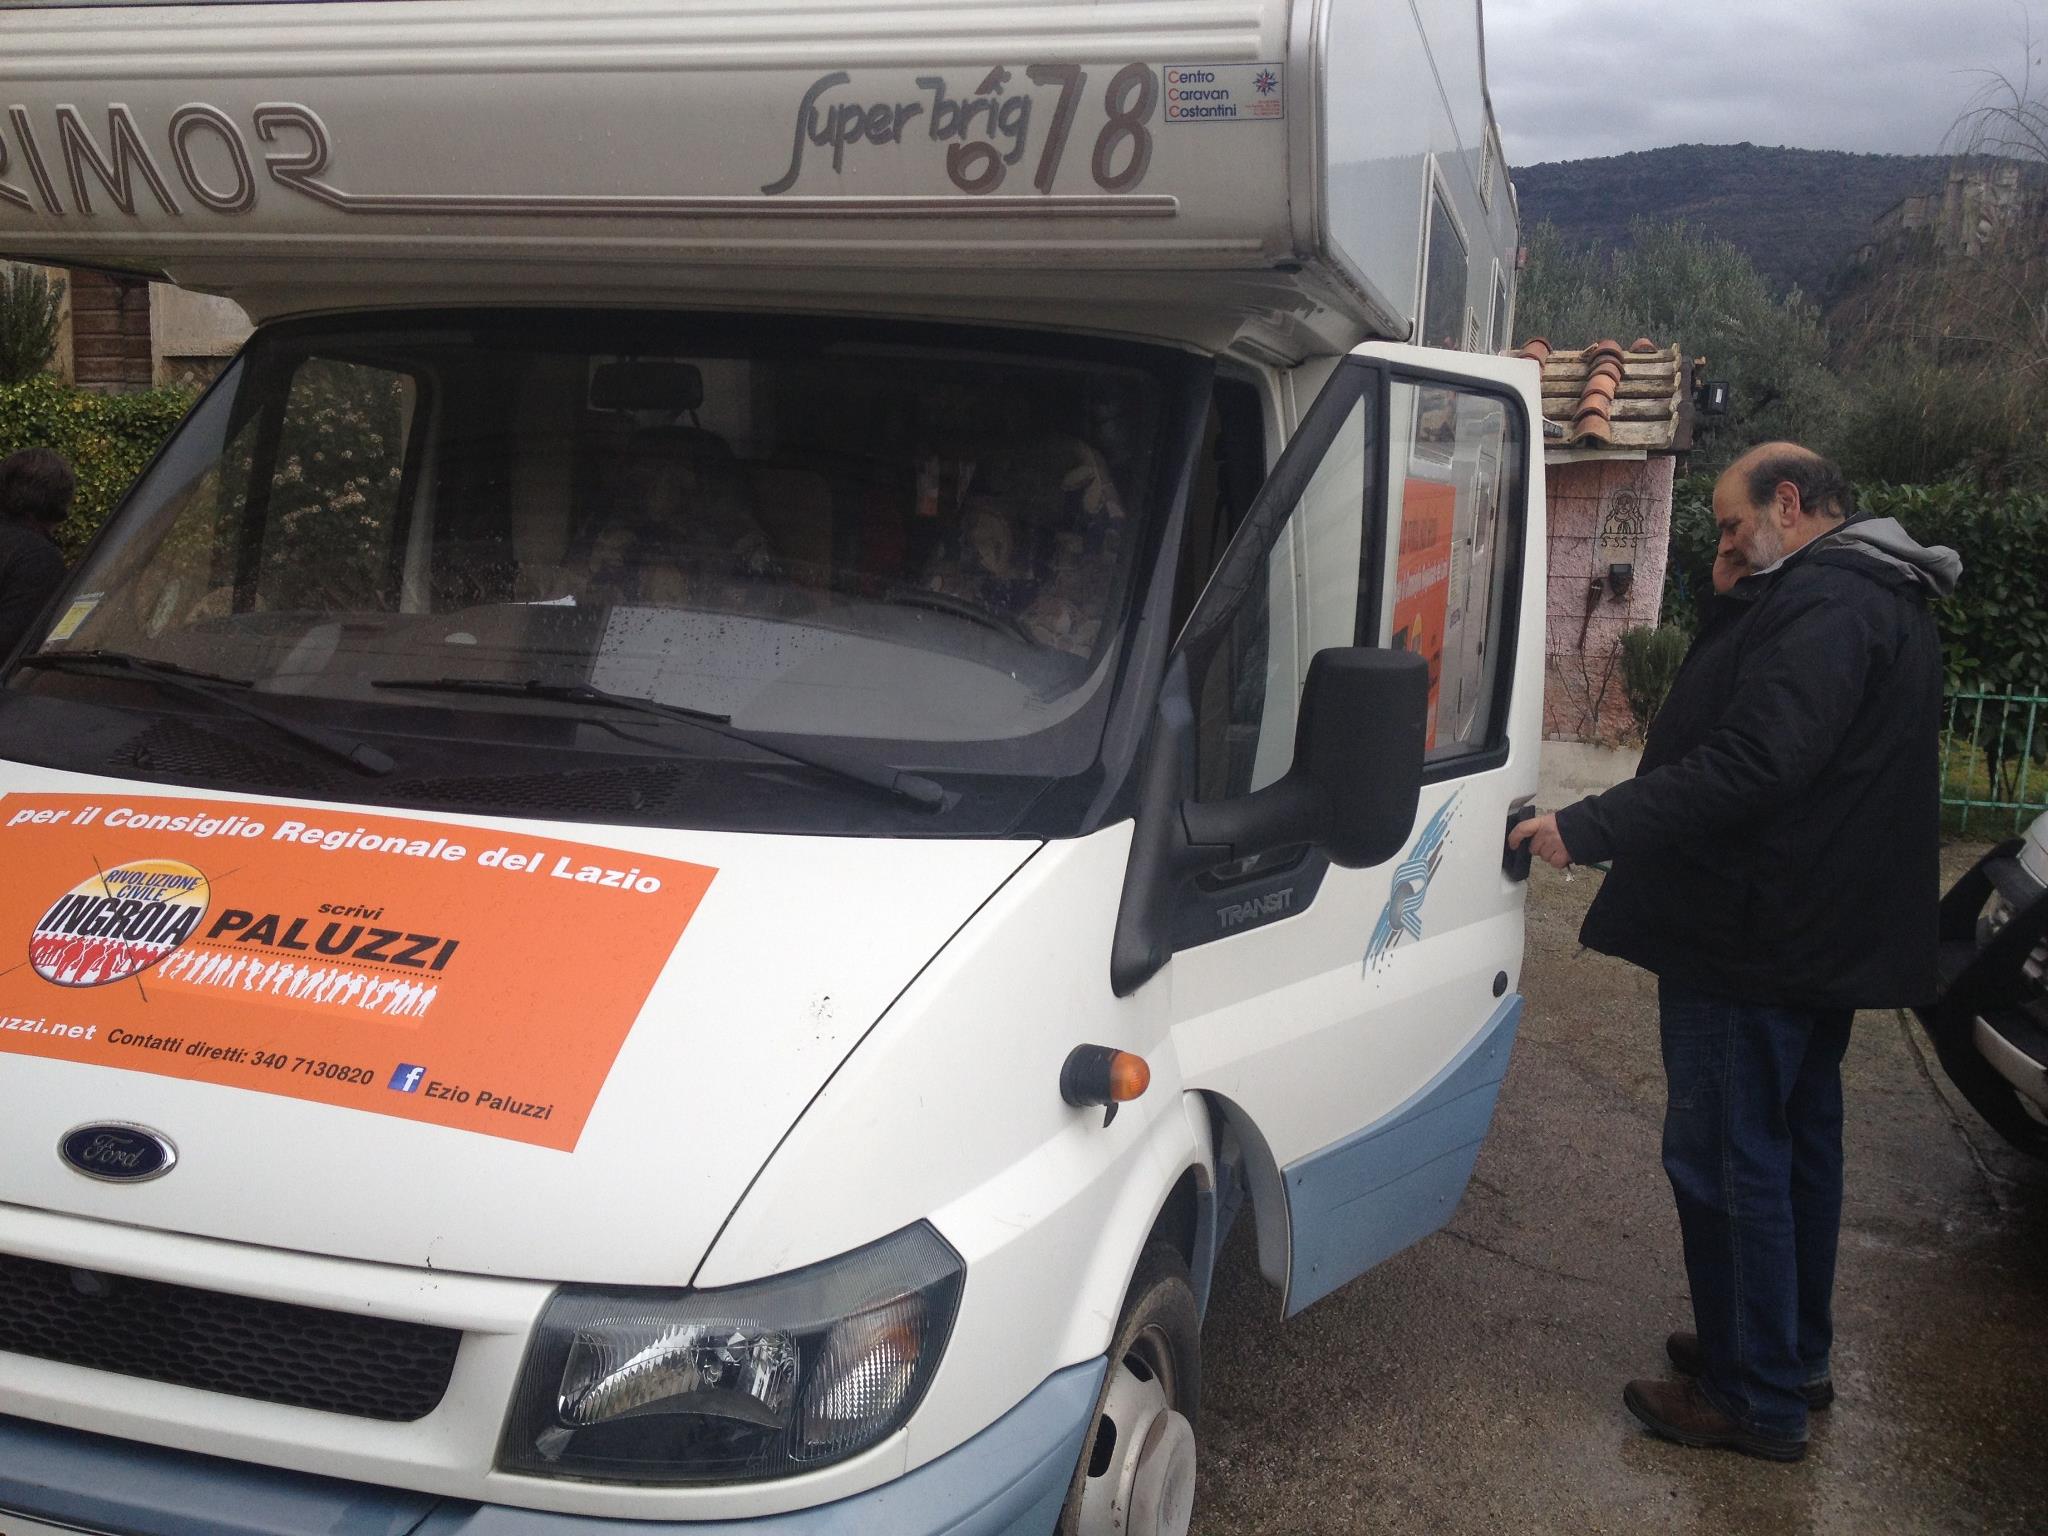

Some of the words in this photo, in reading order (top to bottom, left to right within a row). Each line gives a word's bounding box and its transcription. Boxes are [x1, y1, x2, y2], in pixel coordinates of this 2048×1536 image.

[1168, 70, 1215, 84] Centro
[1168, 88, 1229, 101] Caravan
[1169, 104, 1237, 118] Costantini
[6, 805, 69, 827] per
[72, 806, 102, 826] il
[104, 808, 265, 838] Consiglio
[272, 820, 466, 862] Regionale
[477, 847, 544, 873] del
[550, 856, 661, 893] Lazio
[104, 869, 202, 891] RIVOLUZIONE
[116, 885, 167, 902] CIVILE
[38, 894, 202, 946] INGROIA
[318, 901, 385, 921] scrivi
[1216, 887, 1294, 928] TRANSIT
[206, 908, 460, 971] PALUZZI
[107, 1028, 183, 1053] Contatti
[185, 1041, 249, 1065] diretti:
[250, 1050, 288, 1070] 340
[291, 1056, 375, 1086] 7130820
[425, 1081, 471, 1104] Ezio
[475, 1090, 554, 1121] Paluzzi
[82, 1133, 142, 1169] Ford
